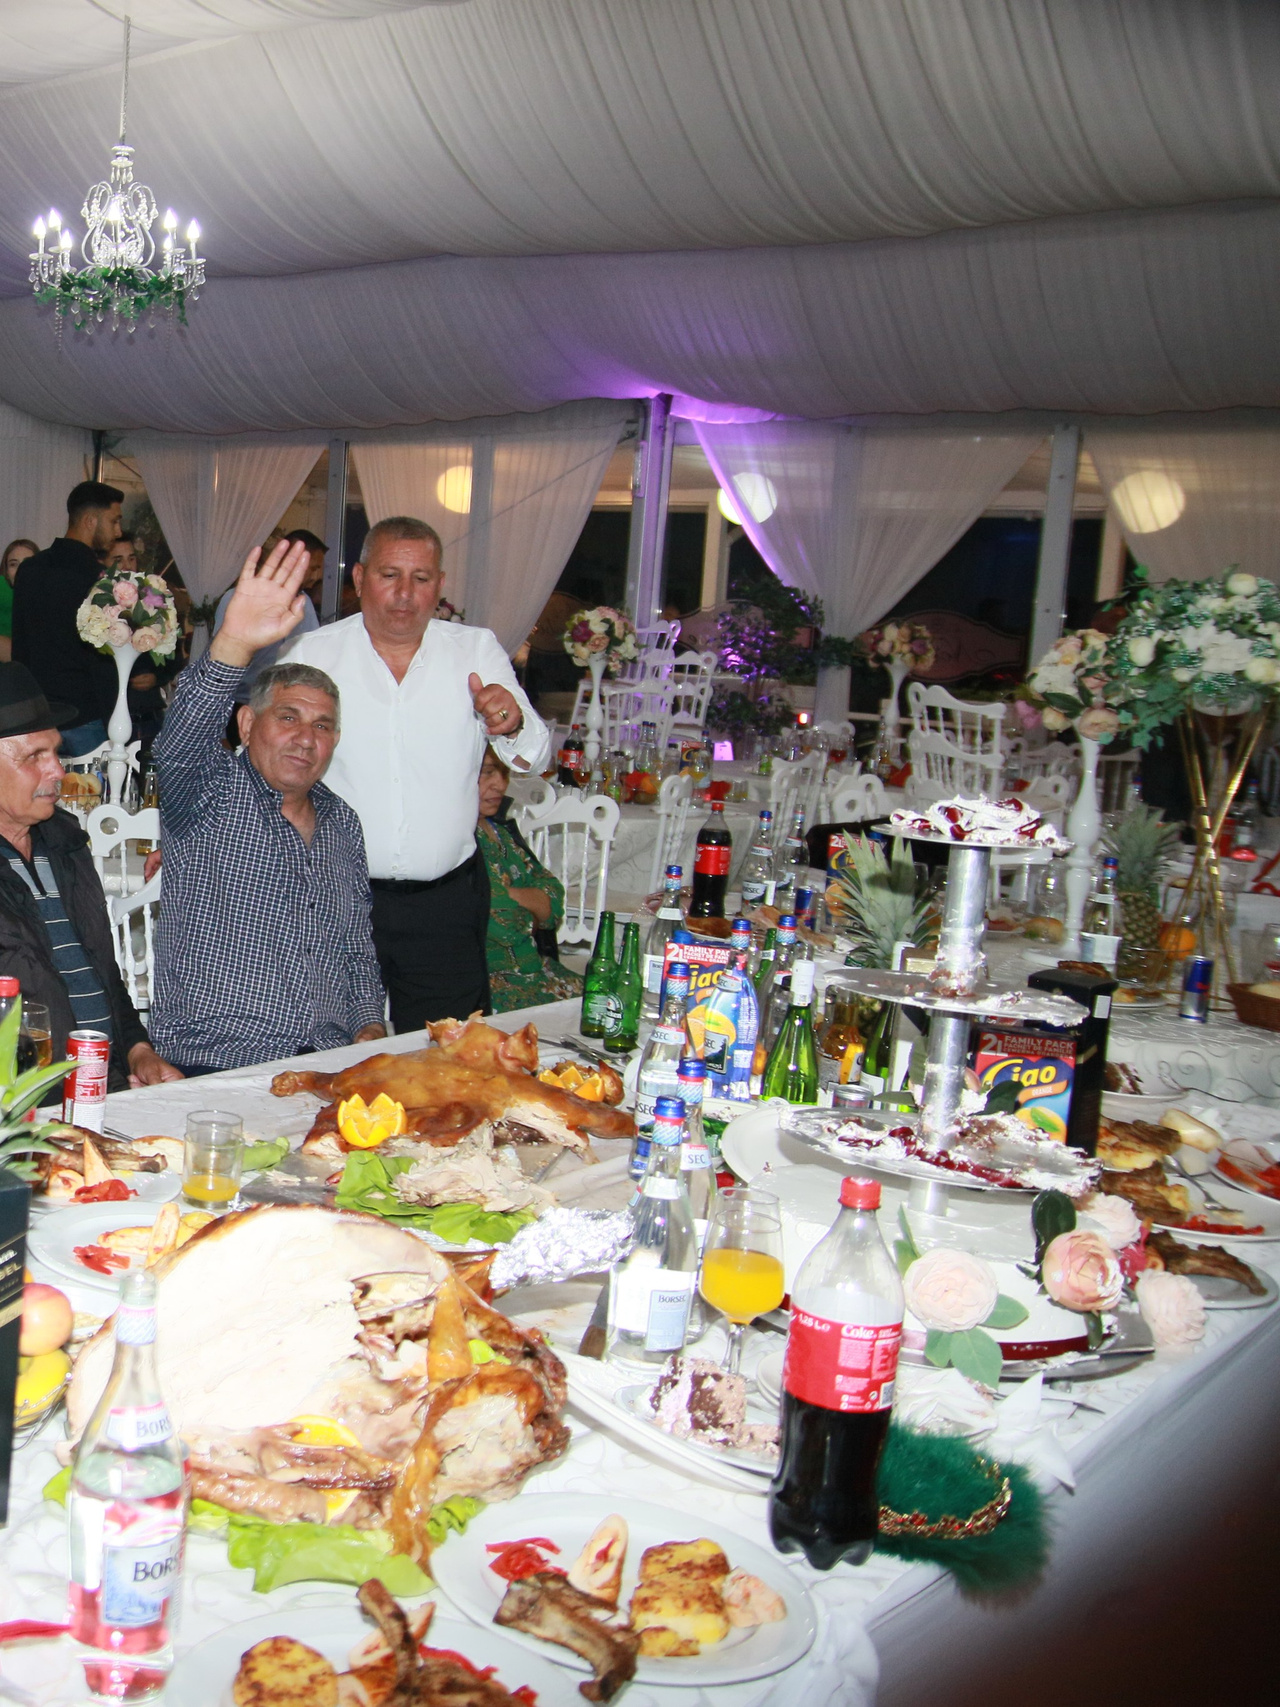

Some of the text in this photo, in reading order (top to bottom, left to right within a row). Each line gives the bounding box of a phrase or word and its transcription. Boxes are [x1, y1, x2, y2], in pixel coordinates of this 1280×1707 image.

[666, 943, 688, 963] 2L
[980, 1034, 1074, 1057] 2L FAMILY PACK
[982, 1058, 1057, 1089] Ciao
